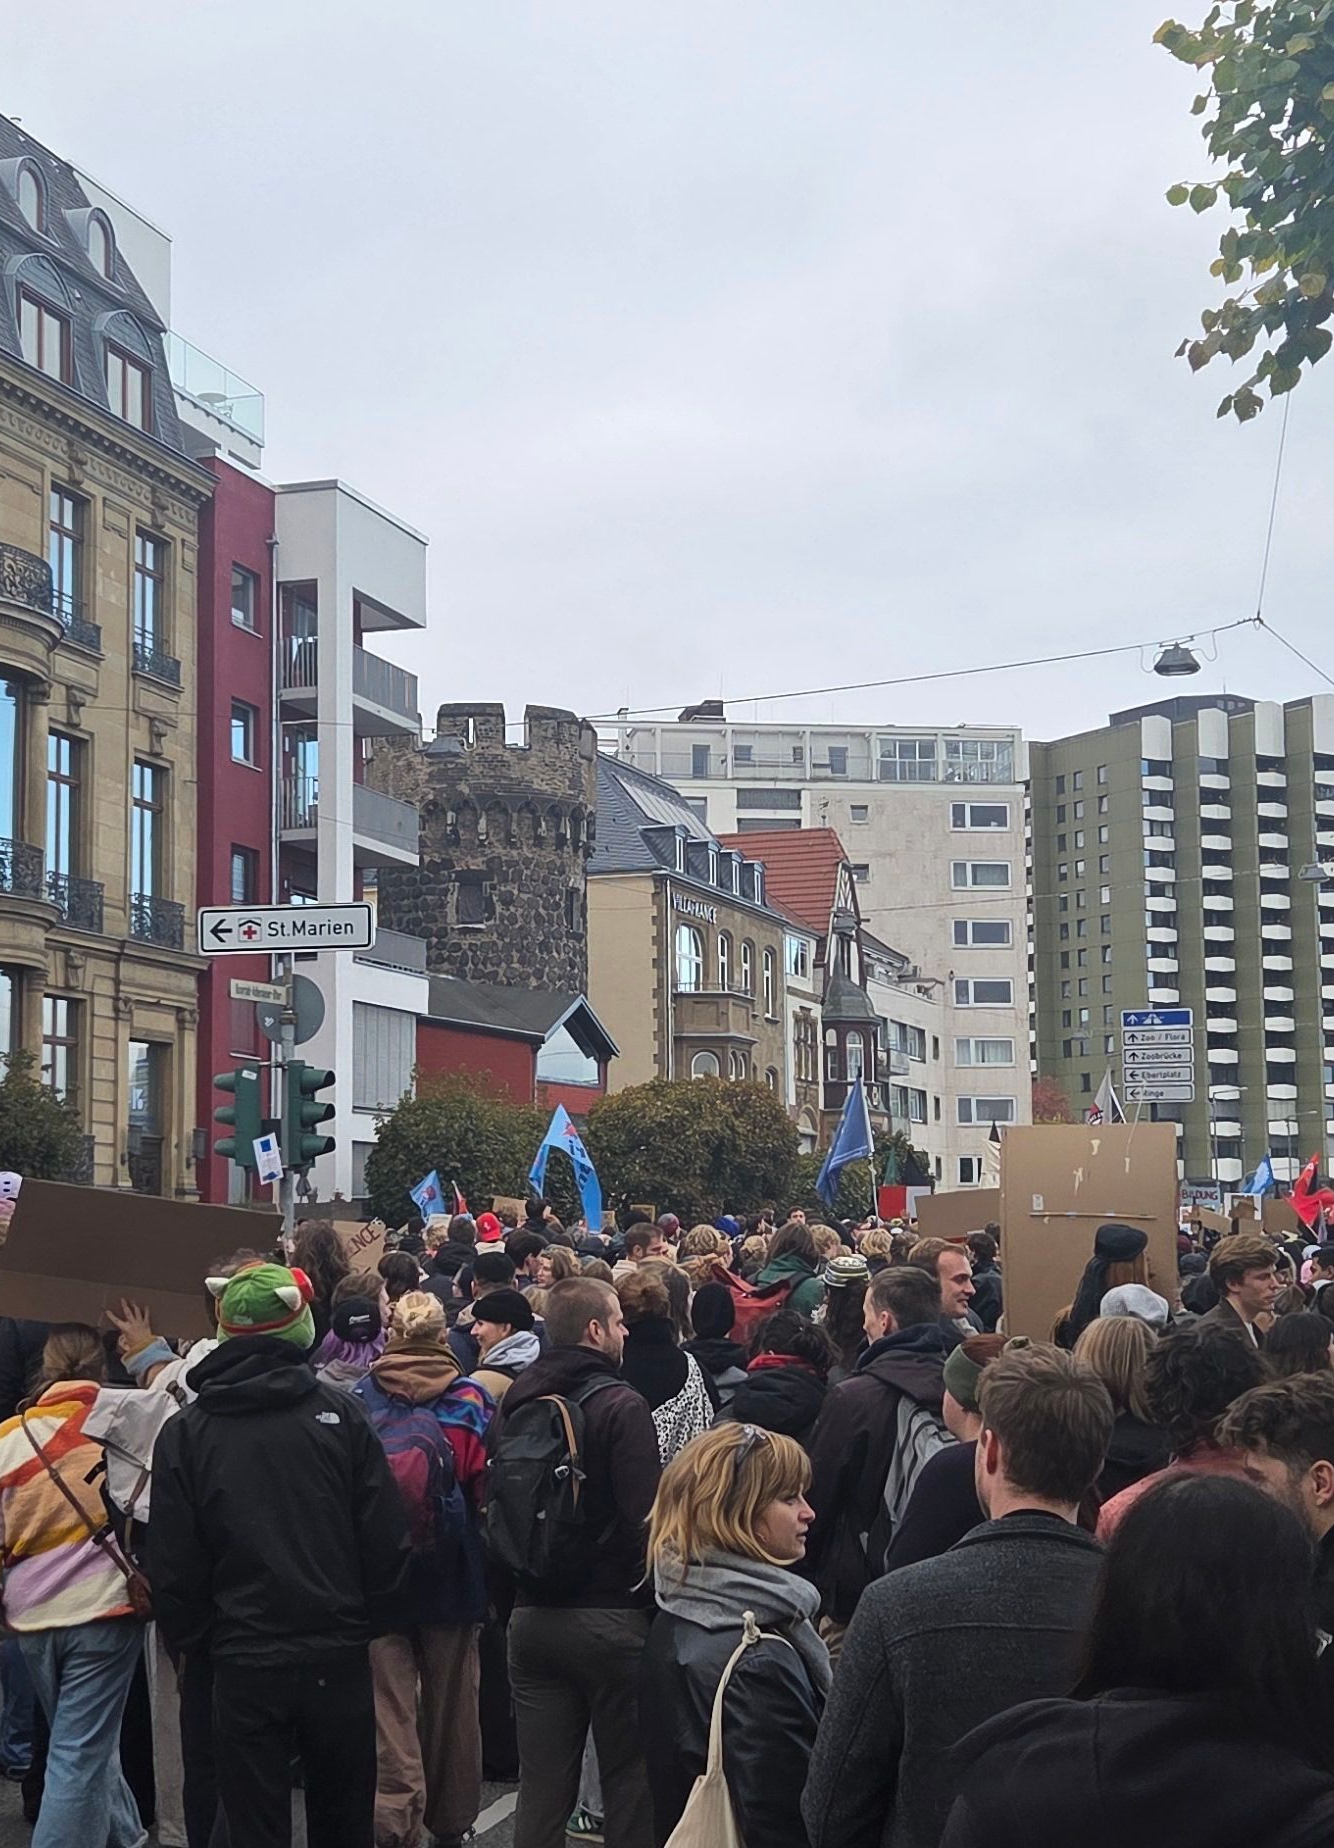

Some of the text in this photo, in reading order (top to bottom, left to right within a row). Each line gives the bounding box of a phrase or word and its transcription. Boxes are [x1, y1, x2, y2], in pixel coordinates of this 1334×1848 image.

[1141, 1034, 1155, 1042] Zoo
[1164, 1033, 1186, 1041] Flora
[1141, 1052, 1182, 1061] Zoobrücke
[1141, 1071, 1181, 1080] Ebertplatz
